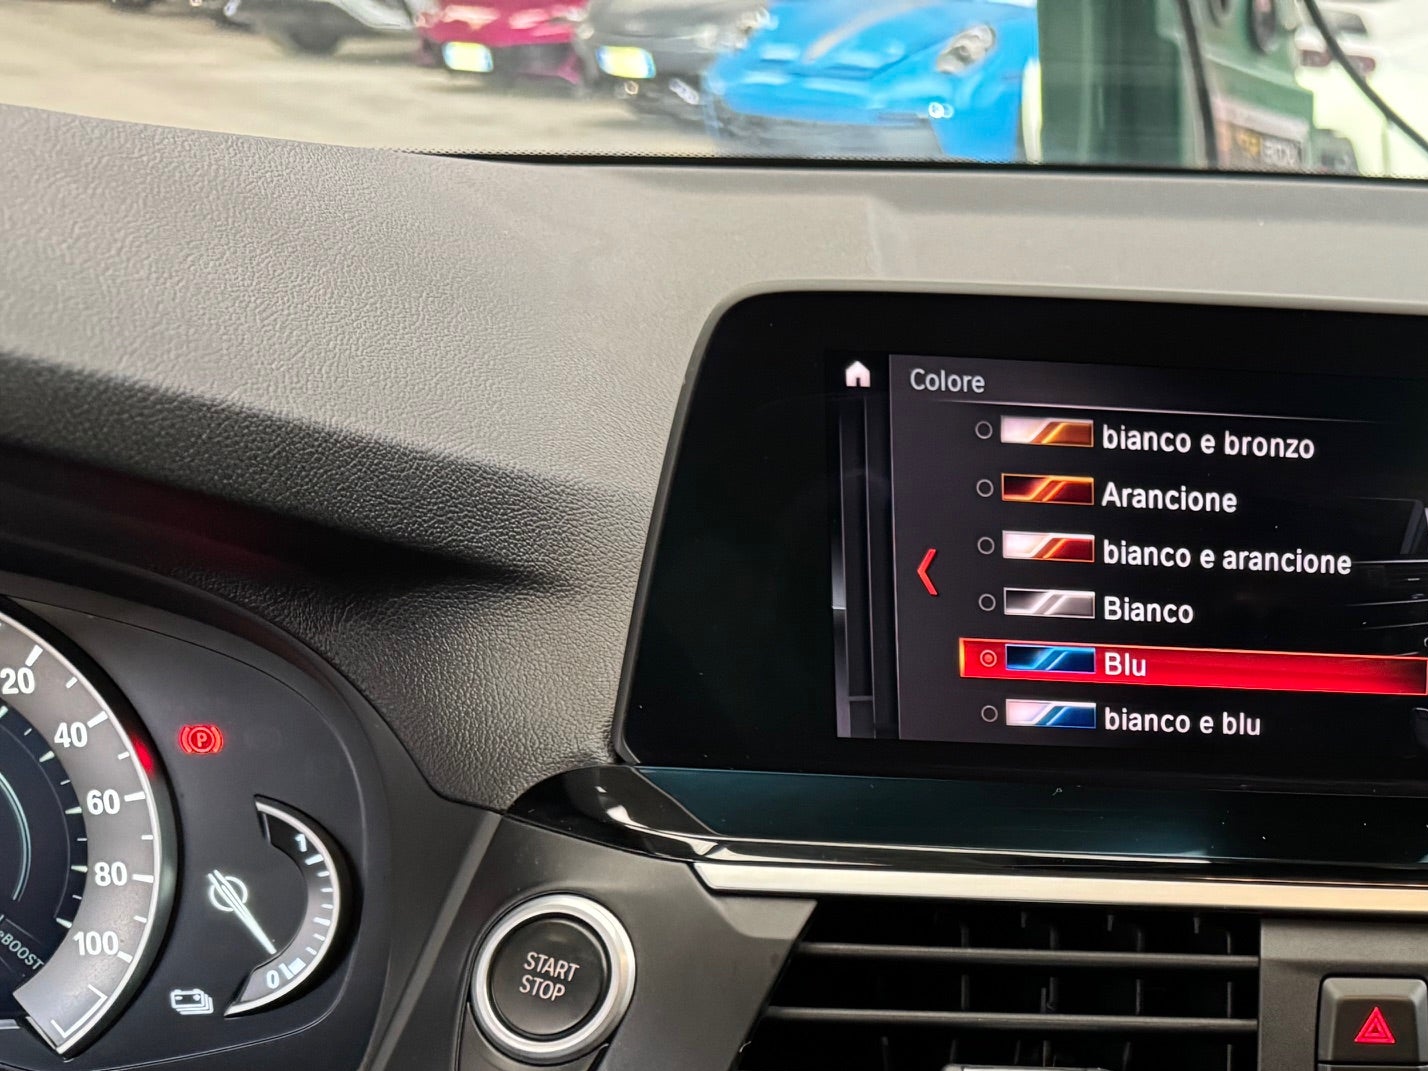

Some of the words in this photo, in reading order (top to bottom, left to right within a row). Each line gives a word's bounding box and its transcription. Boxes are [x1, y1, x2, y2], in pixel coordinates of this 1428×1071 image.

[910, 368, 986, 394] Colore
[1102, 424, 1192, 454] bianco
[1200, 433, 1216, 455] e
[1224, 430, 1315, 460] bronzo
[1101, 481, 1238, 513] Arancione
[1103, 538, 1192, 568] bianco
[1199, 548, 1216, 569] e
[1222, 545, 1352, 575] arancione
[1103, 595, 1194, 624] Bianco
[1104, 650, 1147, 677] Blu
[0, 667, 35, 695] 20
[54, 721, 88, 748] 40
[1104, 706, 1191, 734] bianco
[1199, 715, 1214, 734] e
[1222, 710, 1261, 736] blu
[86, 789, 121, 815] 60
[295, 833, 307, 852] 1
[94, 861, 128, 887] 80
[73, 930, 119, 956] 100
[266, 969, 280, 989] 0
[523, 951, 580, 982] START
[519, 974, 566, 1001] STOP
